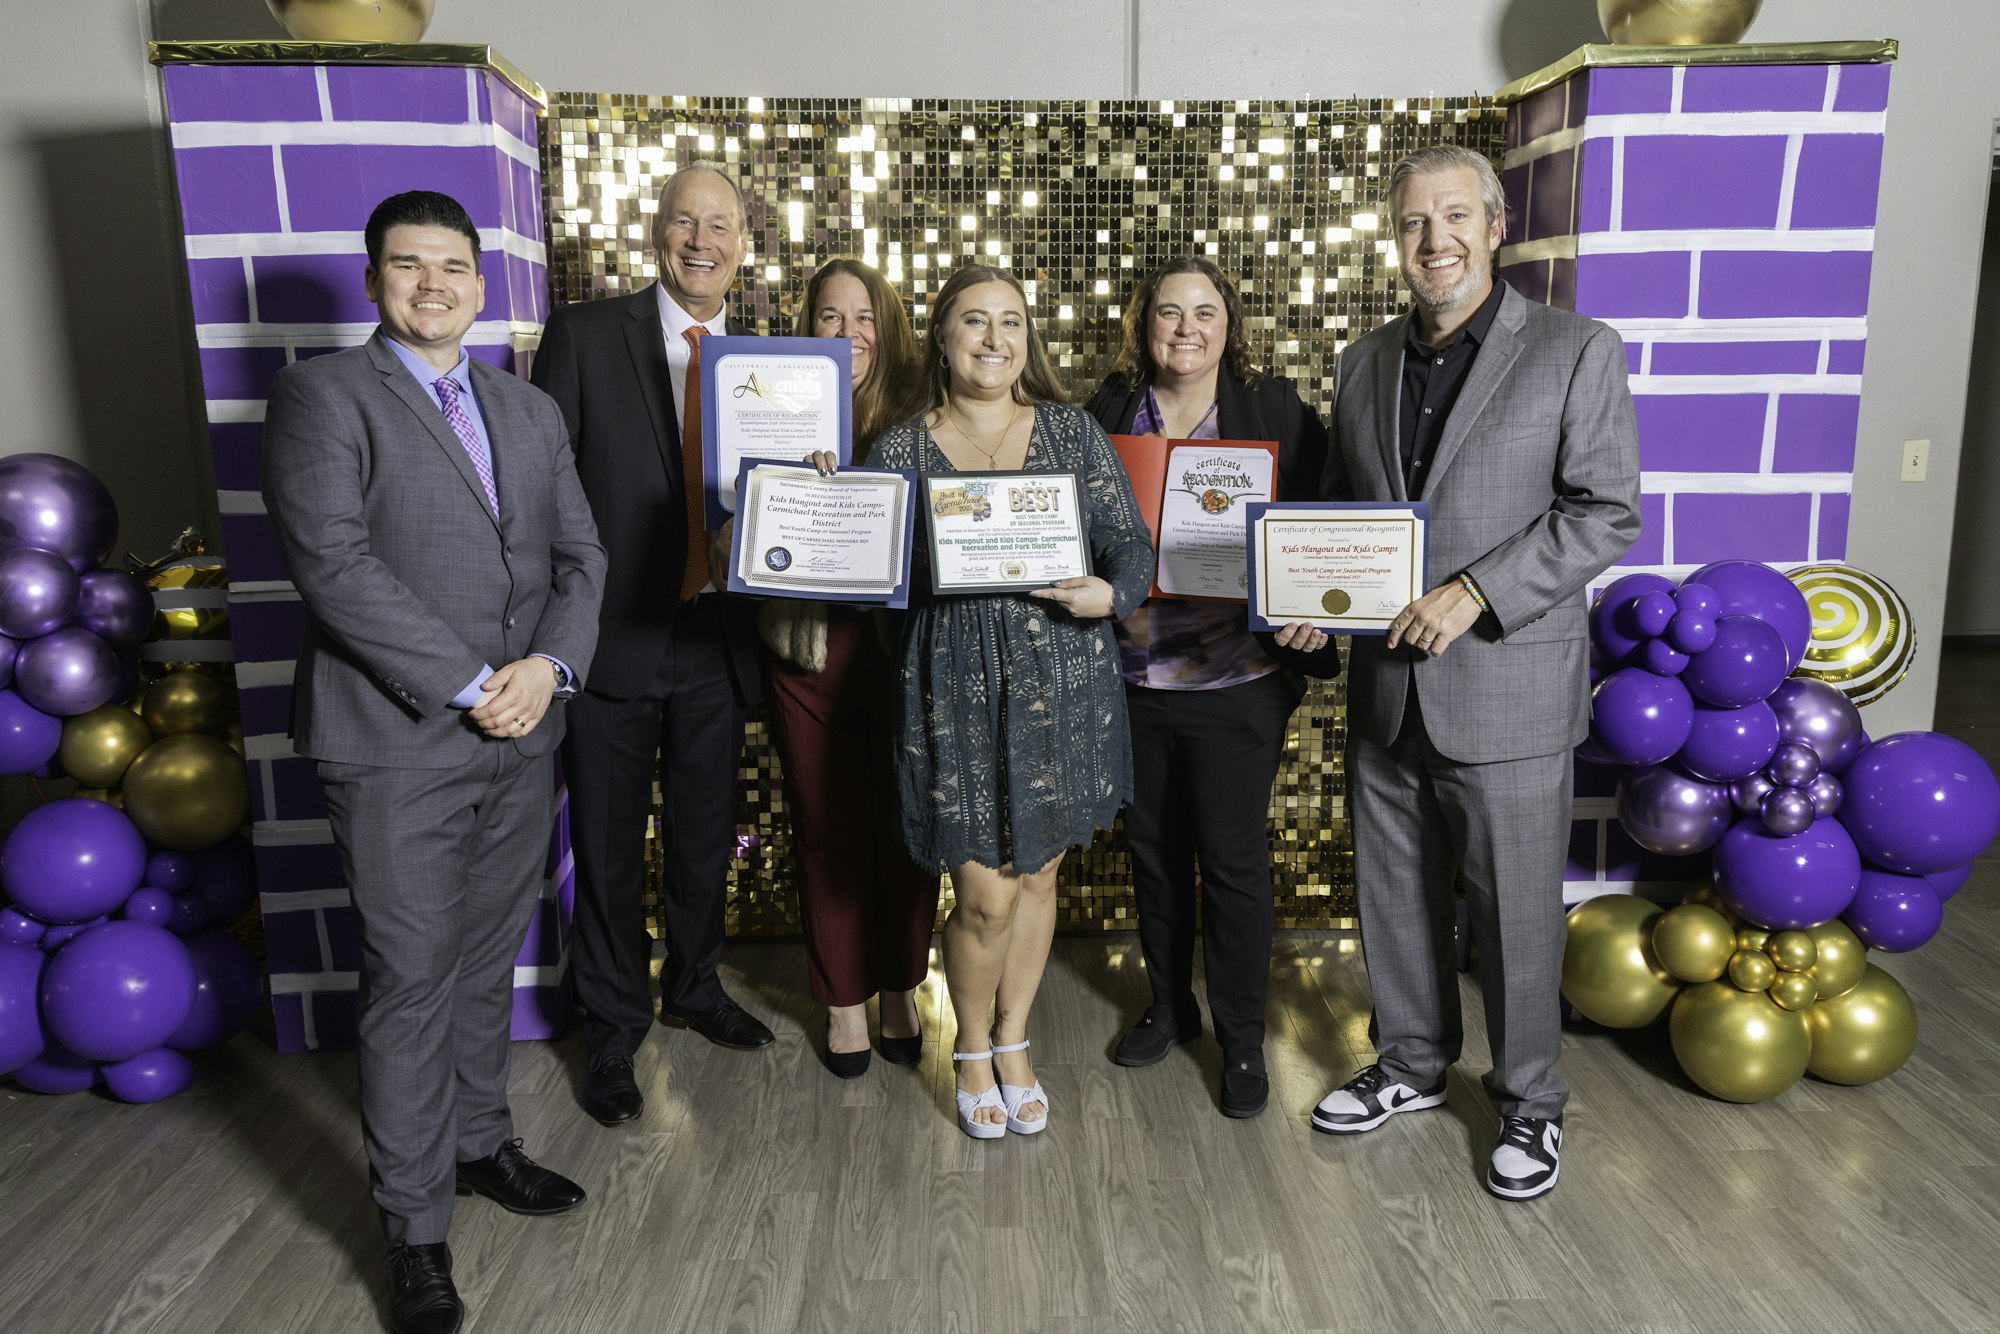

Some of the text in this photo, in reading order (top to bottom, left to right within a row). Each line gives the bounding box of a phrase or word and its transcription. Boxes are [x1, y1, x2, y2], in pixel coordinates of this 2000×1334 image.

[1196, 456, 1241, 470] certificate
[1182, 470, 1253, 490] RECOGNITION
[769, 495, 787, 503] Kids
[789, 496, 821, 507] Hangout
[857, 502, 885, 511] Camps-
[939, 492, 955, 500] Best
[1008, 487, 1061, 512] BEST
[767, 505, 810, 516] Carmichael
[935, 495, 983, 513] Carmichael
[1273, 524, 1406, 535] Certificate of Congressional Recognition
[1282, 545, 1299, 554] Kids
[1300, 545, 1335, 555] Hangout
[1352, 545, 1371, 554] Kids
[1373, 545, 1398, 554] Camps
